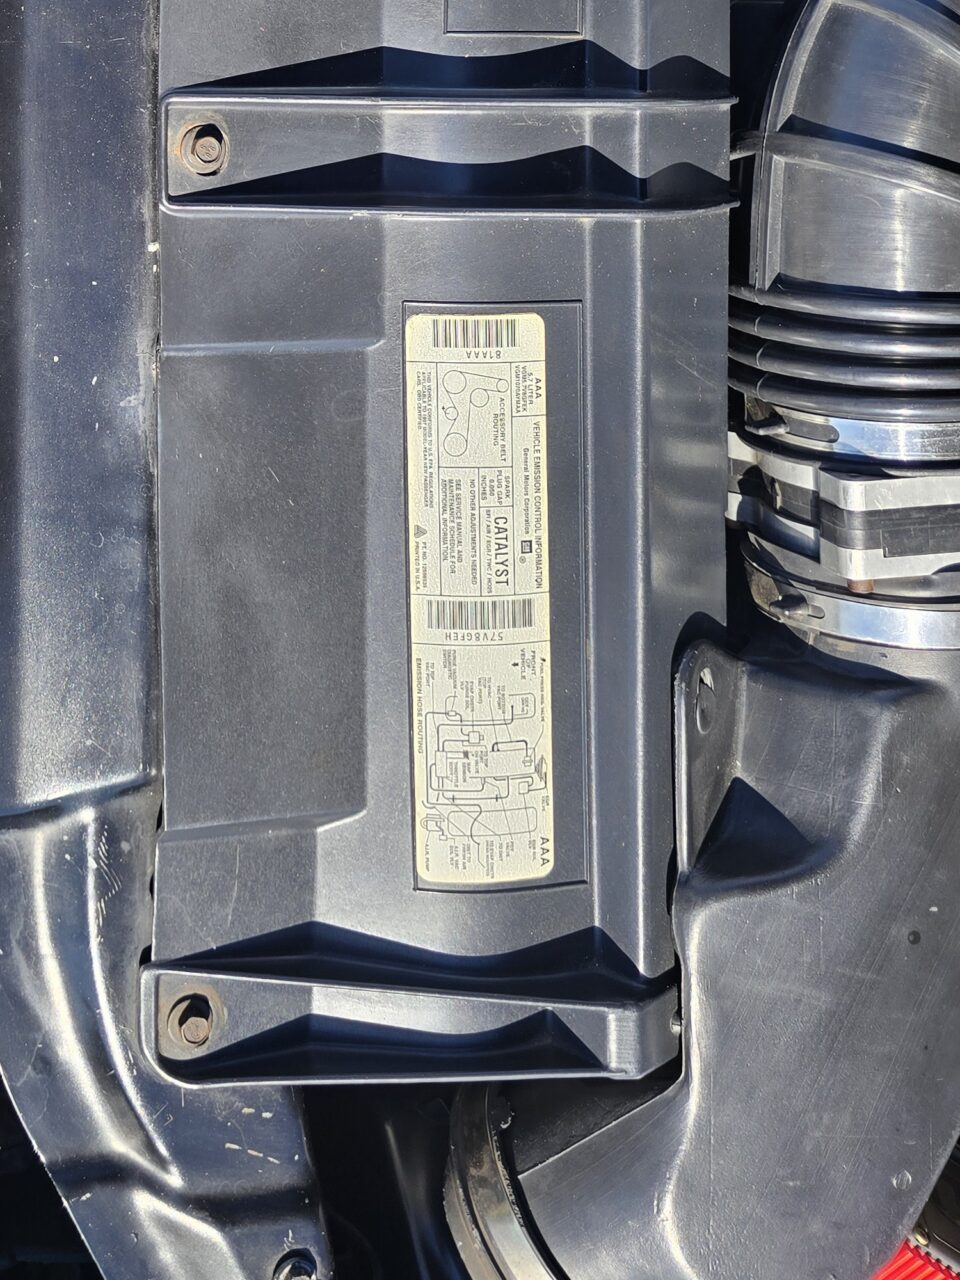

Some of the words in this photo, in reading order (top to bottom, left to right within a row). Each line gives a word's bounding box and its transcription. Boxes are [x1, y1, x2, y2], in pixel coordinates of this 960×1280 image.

[466, 350, 502, 360] 81AAA
[533, 421, 541, 454] VEHICLE
[469, 479, 476, 489] NO
[480, 475, 488, 501] INCHES
[533, 456, 541, 494] EMISSION
[455, 493, 463, 520] SERVICE
[523, 498, 531, 535] Corporation
[534, 495, 542, 534] CONTROL
[494, 516, 509, 586] CATALYST
[534, 535, 543, 589] INFORMATION
[415, 657, 423, 694] EMISSION
[540, 836, 550, 867] AAA
